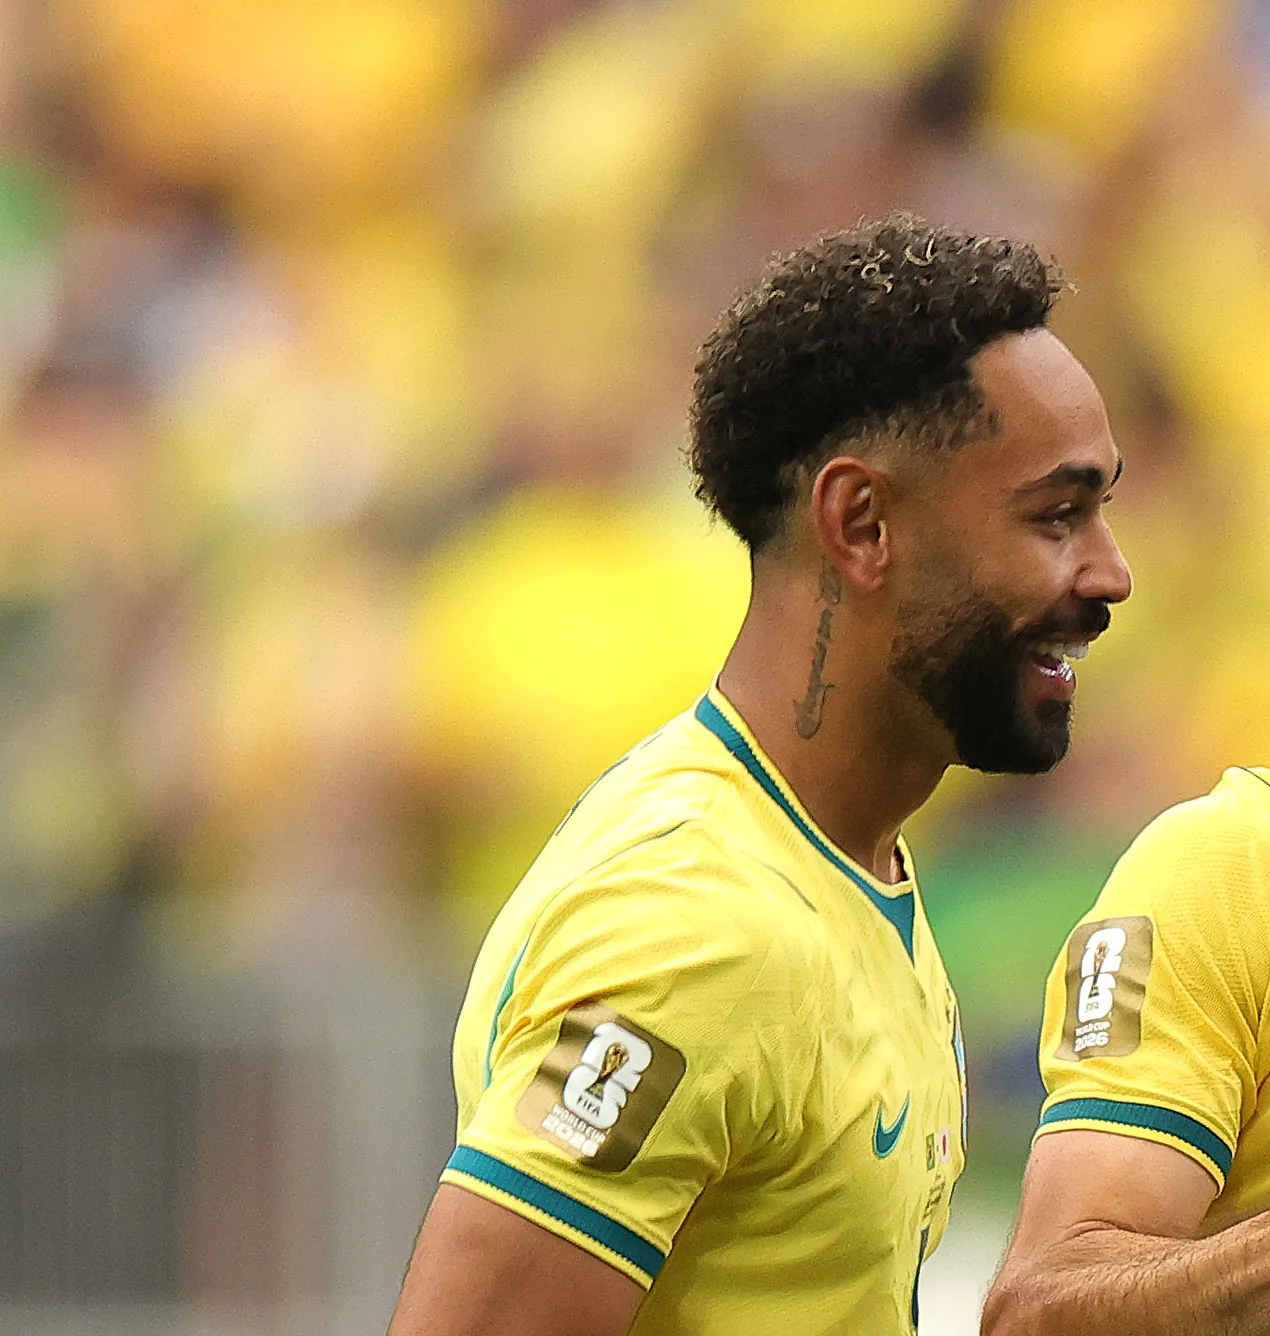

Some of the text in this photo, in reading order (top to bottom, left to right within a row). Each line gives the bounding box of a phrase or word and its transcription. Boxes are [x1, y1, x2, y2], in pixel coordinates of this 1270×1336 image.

[552, 1103, 587, 1136] WORLD
[576, 1094, 602, 1118] FIFA
[541, 1113, 600, 1158] 2026
